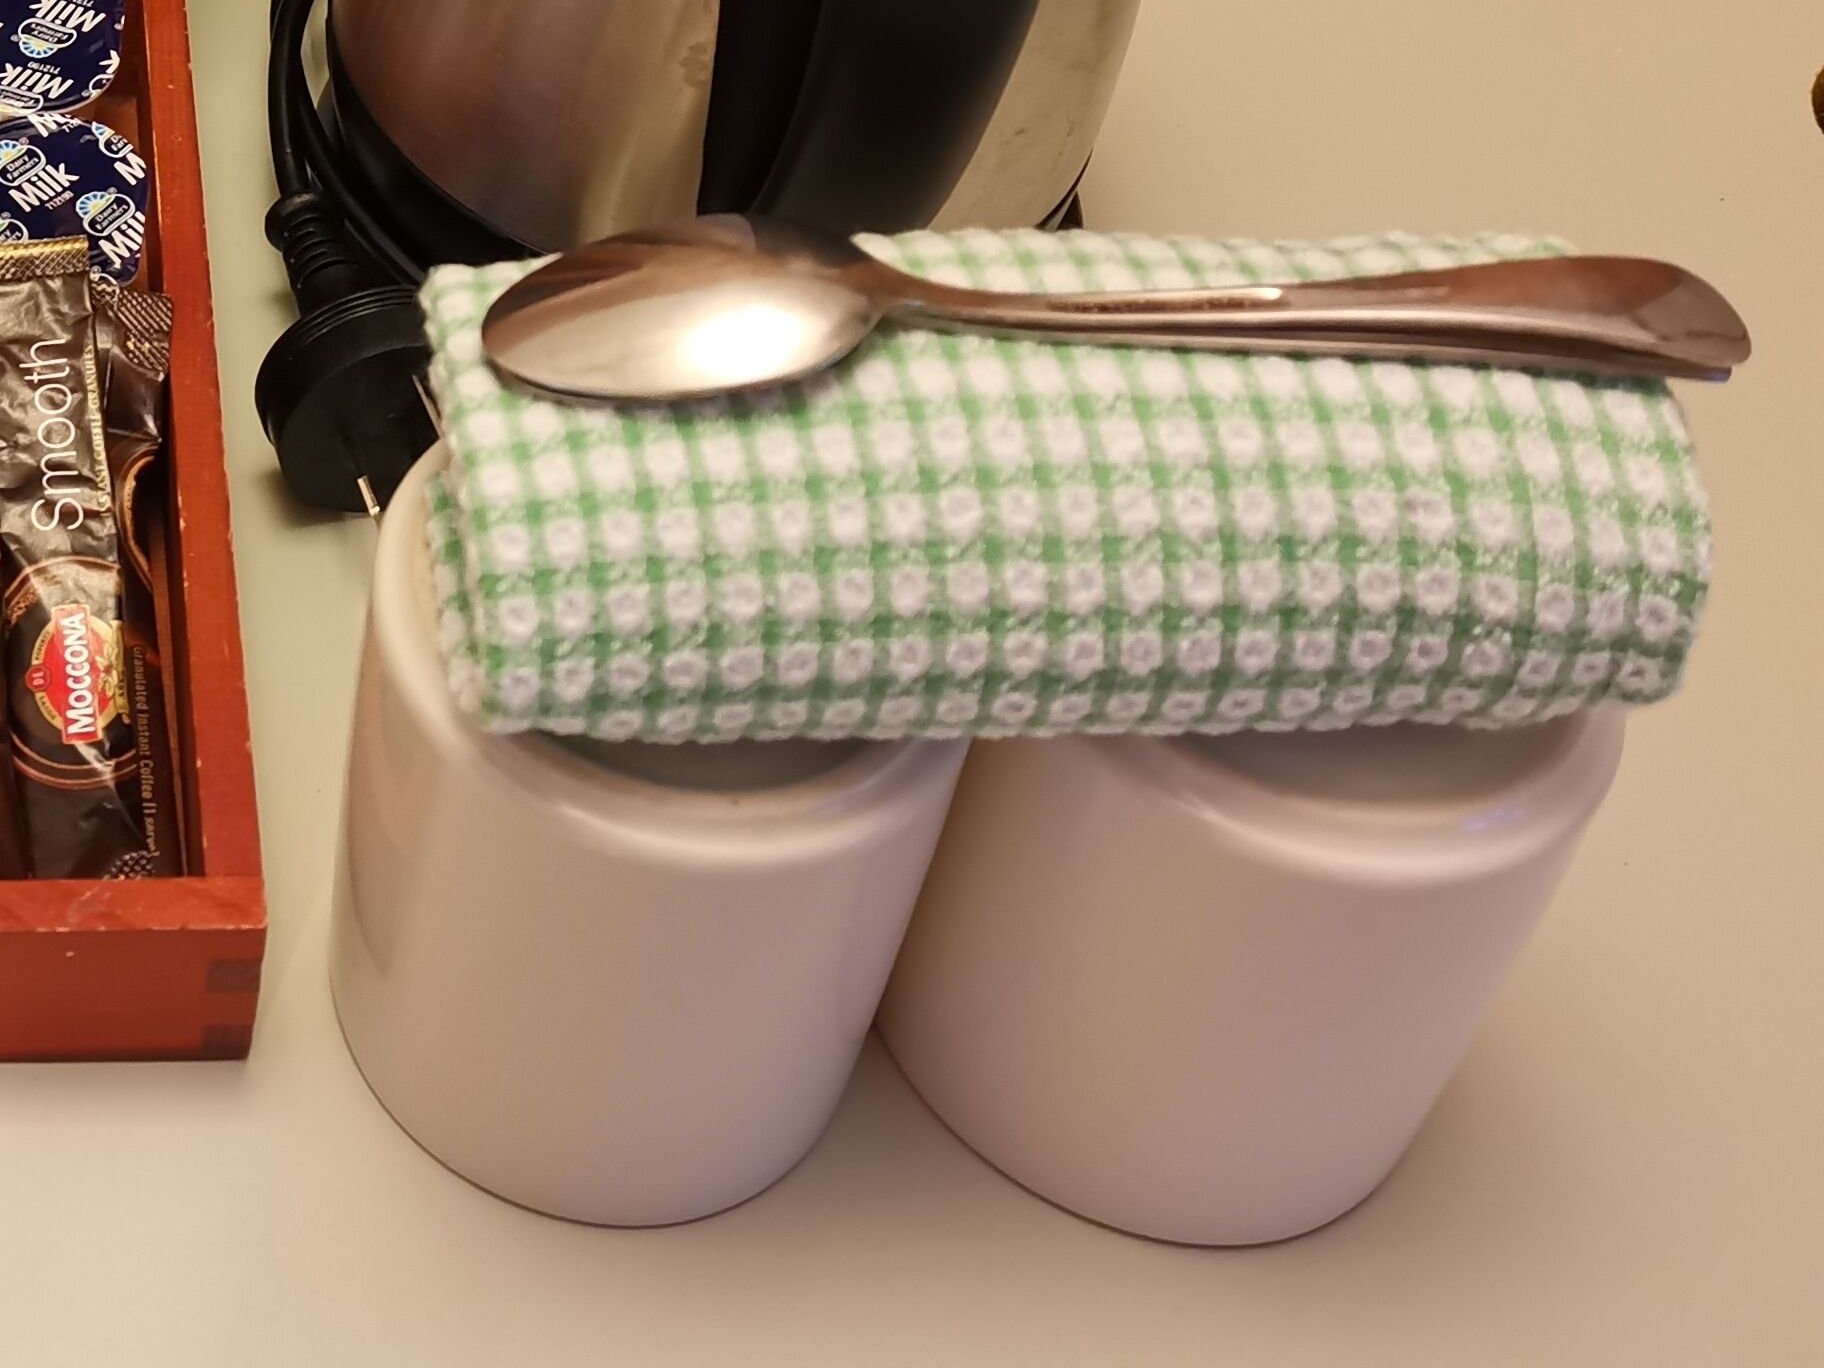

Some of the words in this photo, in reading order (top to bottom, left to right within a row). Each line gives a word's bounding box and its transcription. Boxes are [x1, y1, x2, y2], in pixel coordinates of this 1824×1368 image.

[8, 163, 80, 212] Milk
[18, 338, 84, 532] Smooth
[61, 611, 97, 735] MOCCONA
